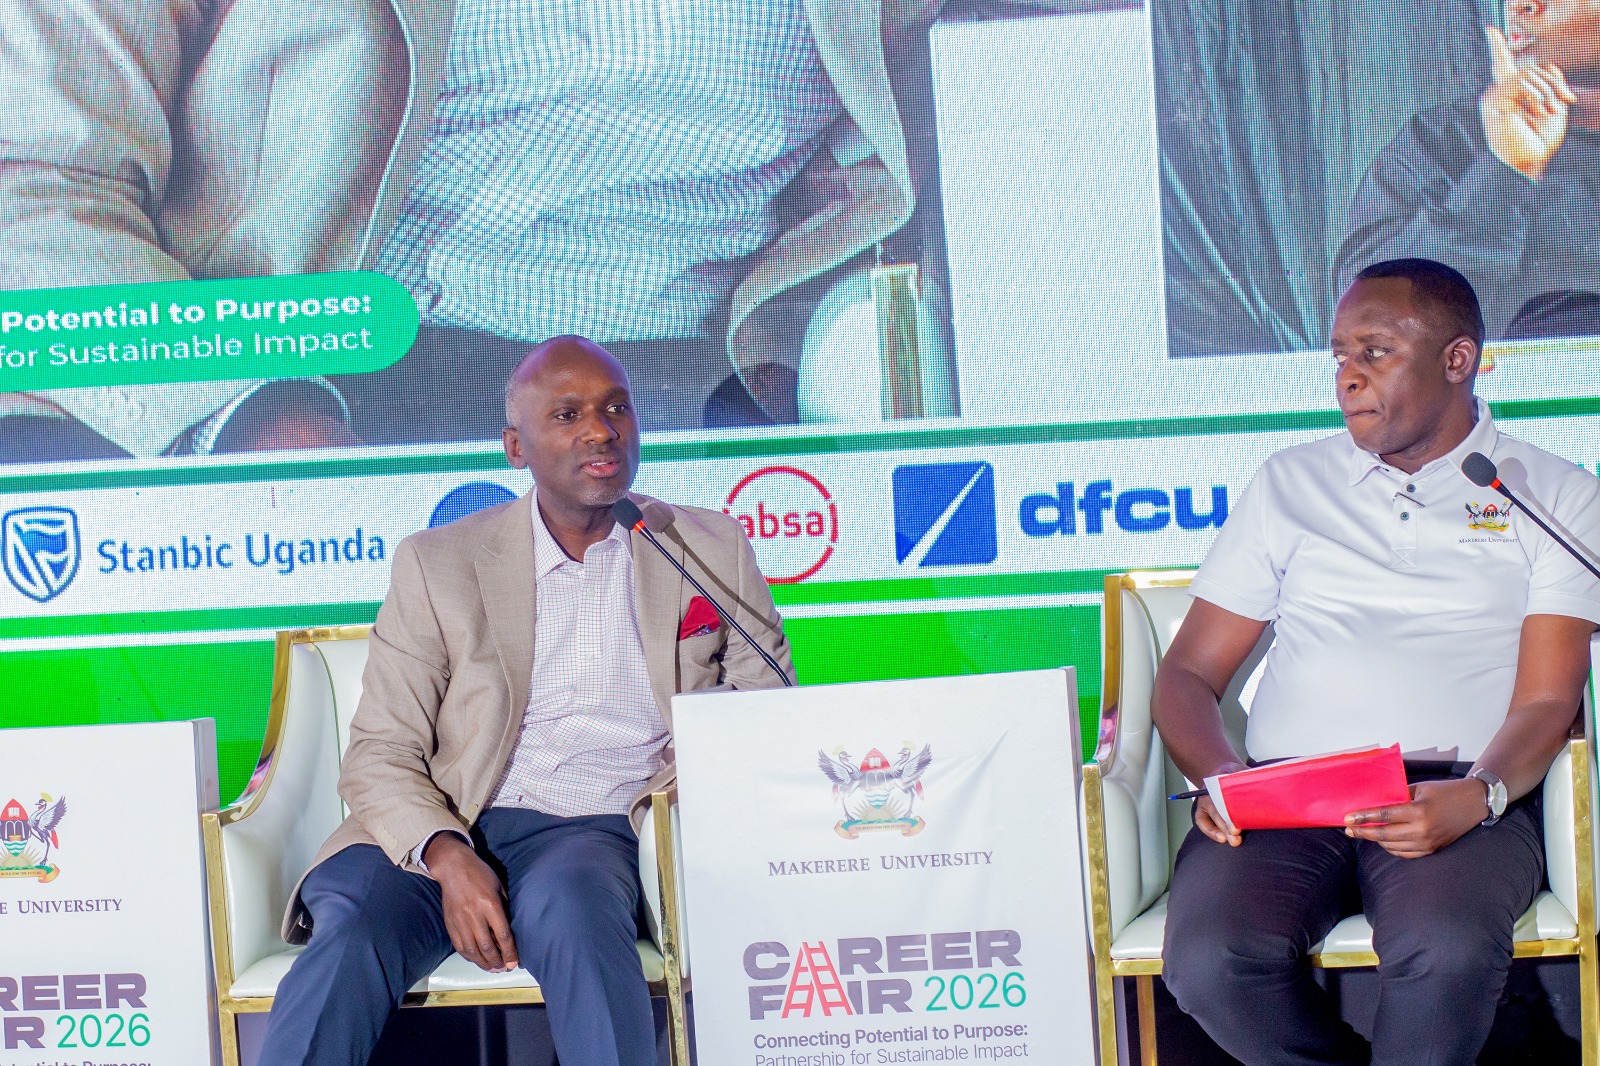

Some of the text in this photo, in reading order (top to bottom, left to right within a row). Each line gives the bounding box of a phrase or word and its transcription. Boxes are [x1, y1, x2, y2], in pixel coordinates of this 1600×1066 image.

[2, 295, 372, 333] Potential to Purpose:
[49, 332, 243, 366] Sustainable
[255, 328, 373, 358] Impact
[738, 501, 824, 539] absa
[1019, 479, 1229, 539] dfcu
[97, 527, 385, 576] Stanbic Uganda
[768, 851, 994, 876] MAKERERE UNIVERSITY
[18, 898, 122, 914] UNIVERSITY
[743, 929, 1023, 981] CAREER
[748, 971, 1027, 1020] FAIR 2026
[56, 1013, 151, 1048] 2026
[754, 1024, 1028, 1049] Connecting Potential to Purpose:
[755, 1042, 1029, 1066] Partnership for Sustainable Impact
